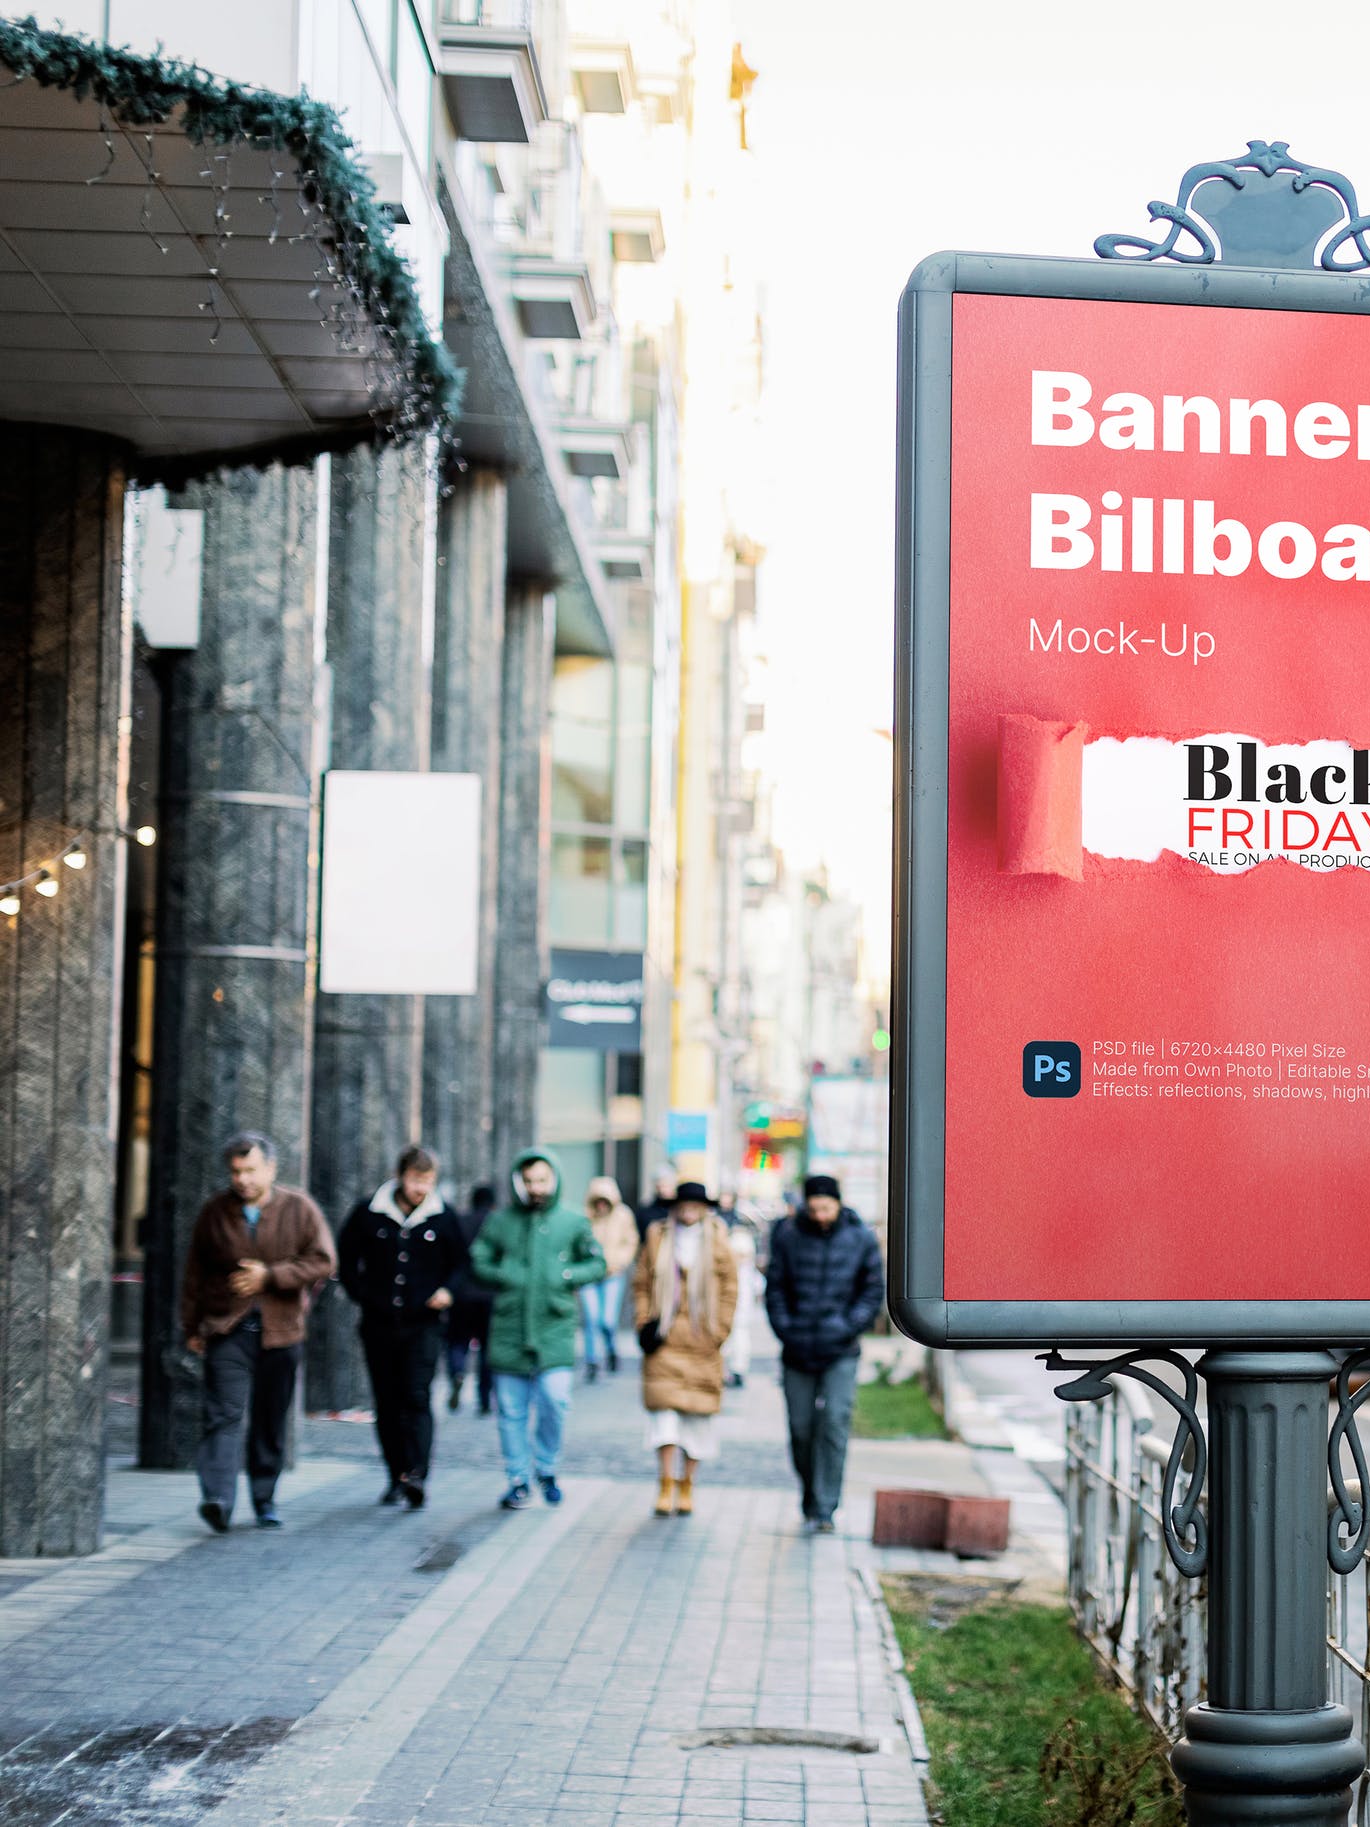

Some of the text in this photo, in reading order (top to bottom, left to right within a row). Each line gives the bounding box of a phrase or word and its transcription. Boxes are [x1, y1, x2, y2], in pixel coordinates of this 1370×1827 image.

[1028, 617, 1216, 665] Mock-Up
[1188, 851, 1228, 865] SALE
[1233, 852, 1260, 866] ON
[1092, 1041, 1126, 1056] PSD
[1131, 1041, 1155, 1056] file
[1271, 1043, 1307, 1058] Pixel
[1312, 1044, 1346, 1058] Size
[1034, 1054, 1072, 1083] Ps
[1092, 1062, 1138, 1077] Made
[1143, 1062, 1179, 1077] from
[1184, 1063, 1221, 1077] Own
[1226, 1063, 1272, 1078] Photo
[1287, 1063, 1351, 1079] Editable
[1092, 1082, 1153, 1098] Effects:
[1158, 1083, 1246, 1100] reflections,
[1252, 1084, 1327, 1100] shadows,
